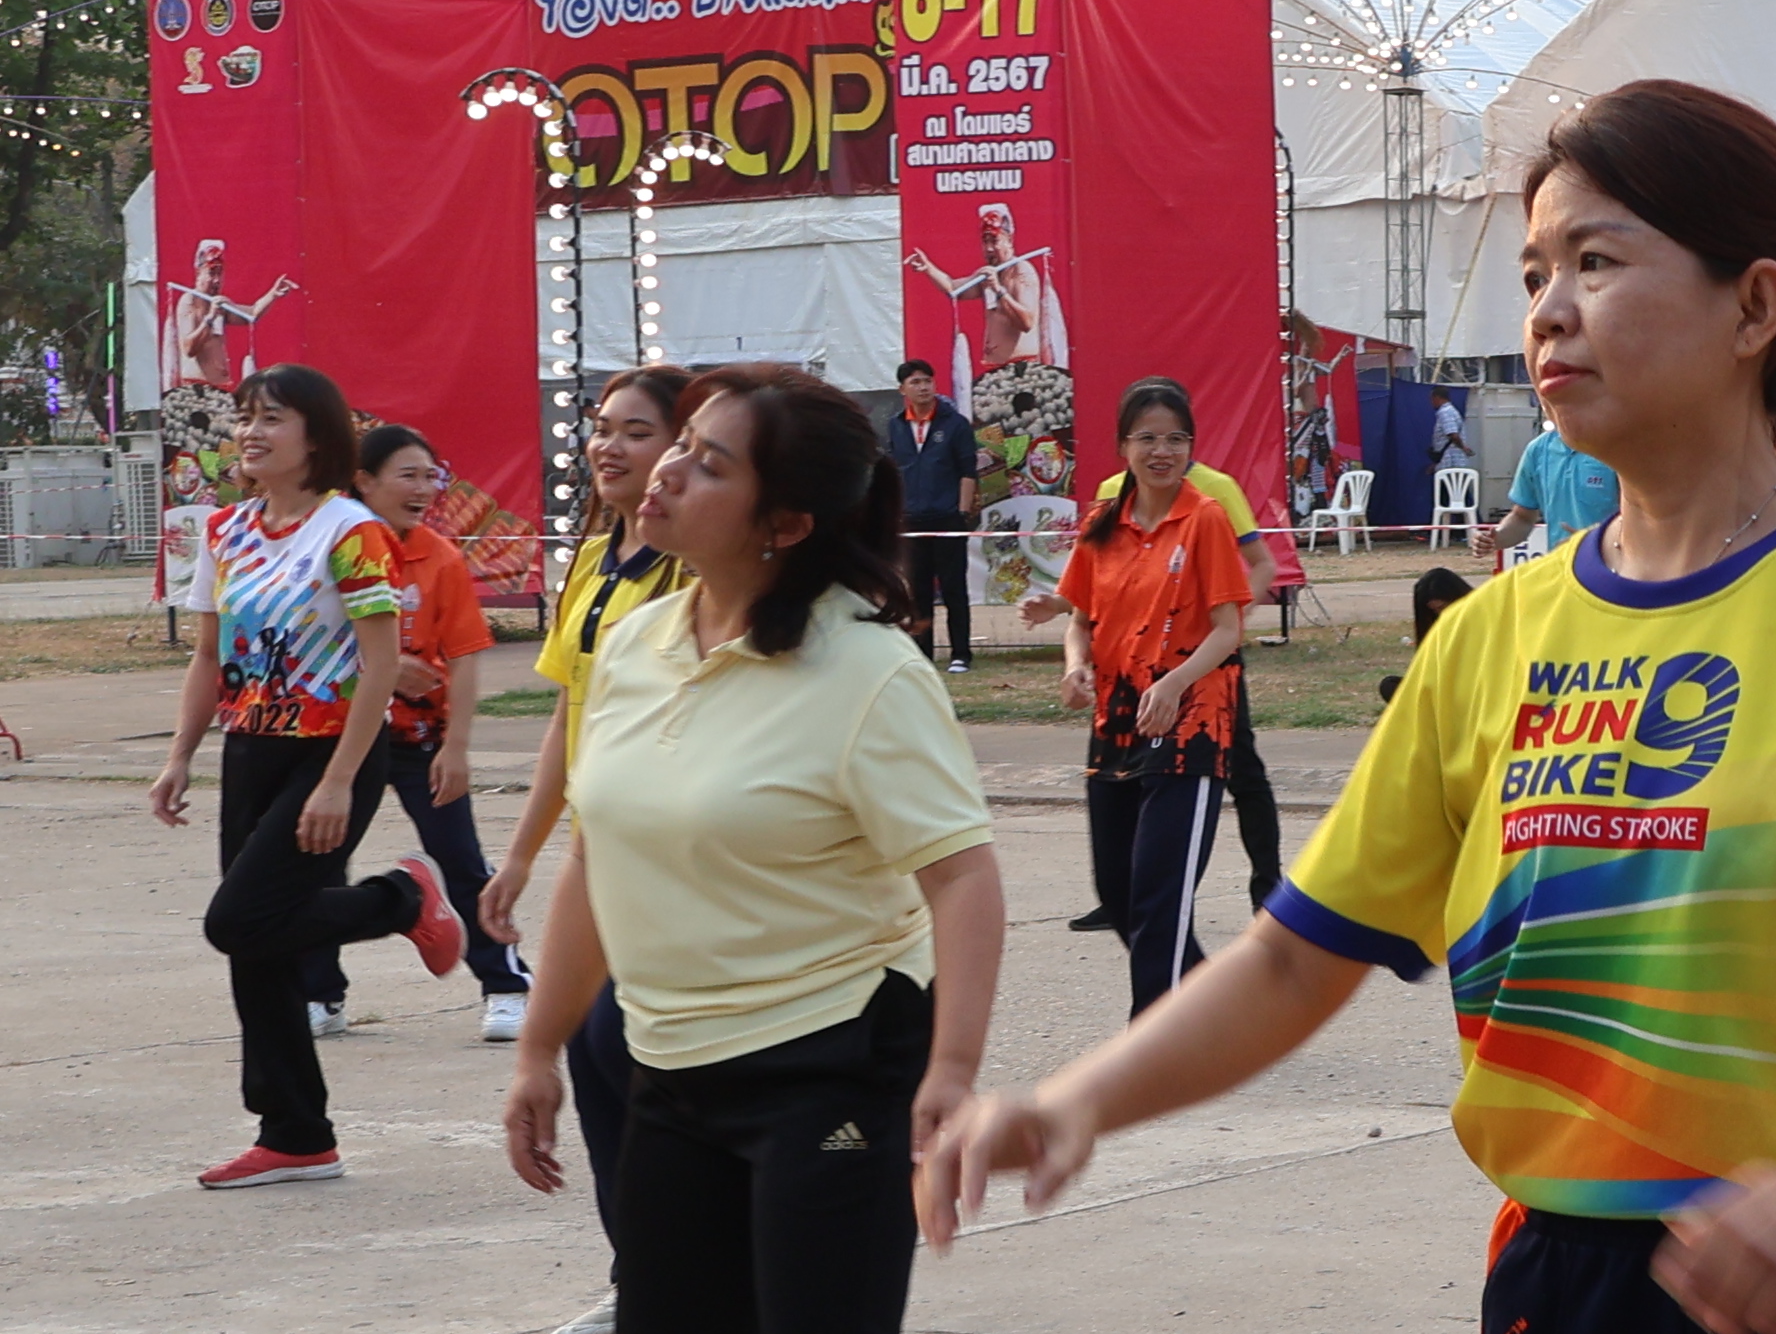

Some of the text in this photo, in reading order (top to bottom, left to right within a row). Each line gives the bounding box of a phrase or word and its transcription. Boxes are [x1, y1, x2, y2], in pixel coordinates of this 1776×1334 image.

[900, 54, 1050, 96] มี.ค. 2567
[542, 52, 888, 188] OTOP
[954, 105, 1032, 136] โดมแอร์
[906, 140, 1055, 166] สนามศาลากลาง
[936, 169, 1023, 193] นครพนม
[1527, 655, 1650, 697] WALK
[1511, 652, 1740, 799] RUN 9
[1500, 752, 1622, 803] BIKE
[1503, 812, 1697, 845] FIGHTING STROKE
